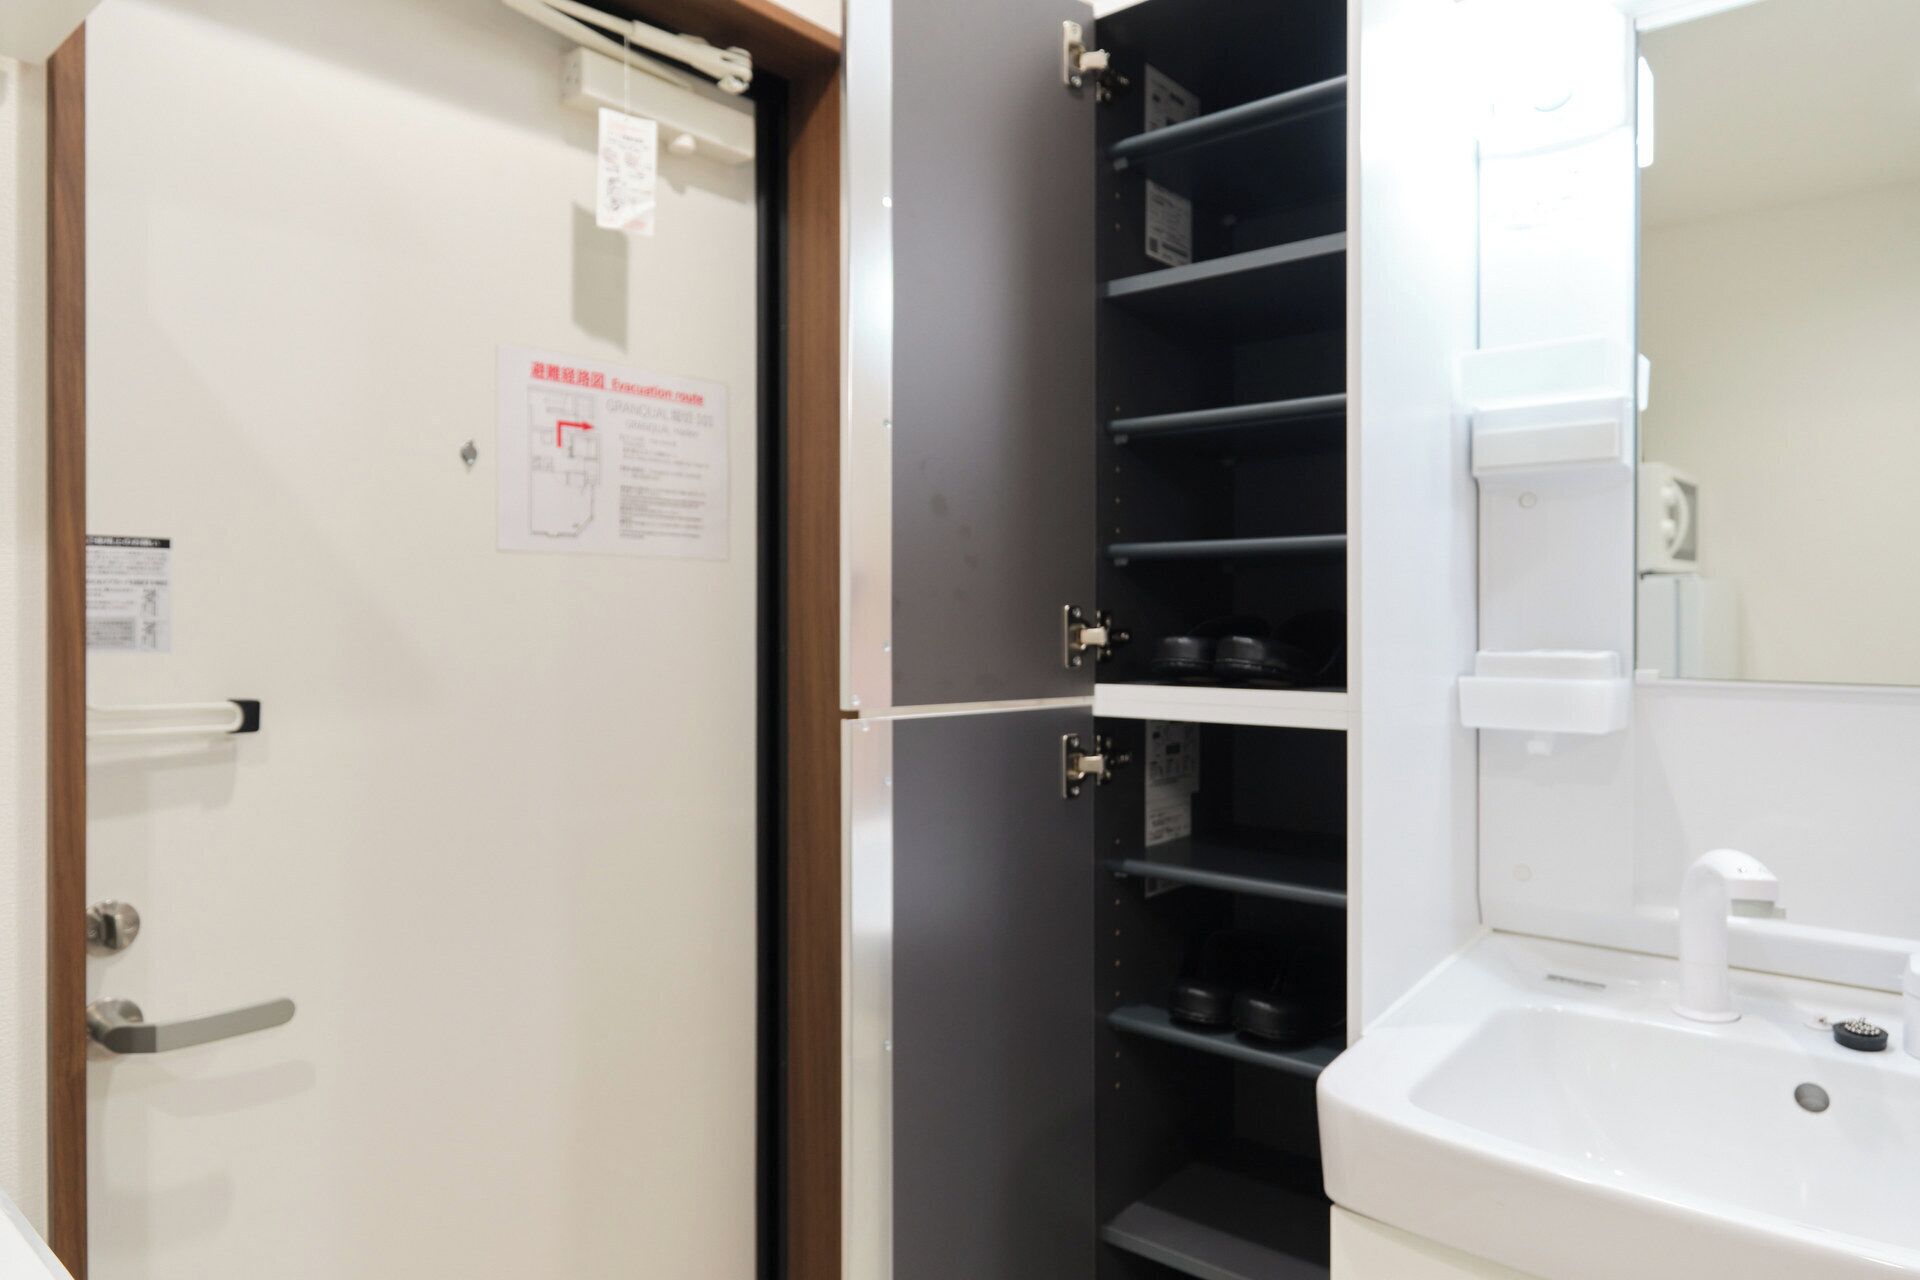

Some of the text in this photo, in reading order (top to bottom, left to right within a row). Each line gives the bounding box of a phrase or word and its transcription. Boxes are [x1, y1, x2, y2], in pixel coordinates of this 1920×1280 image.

[532, 362, 704, 406] 避難経路図 Evacuation route
